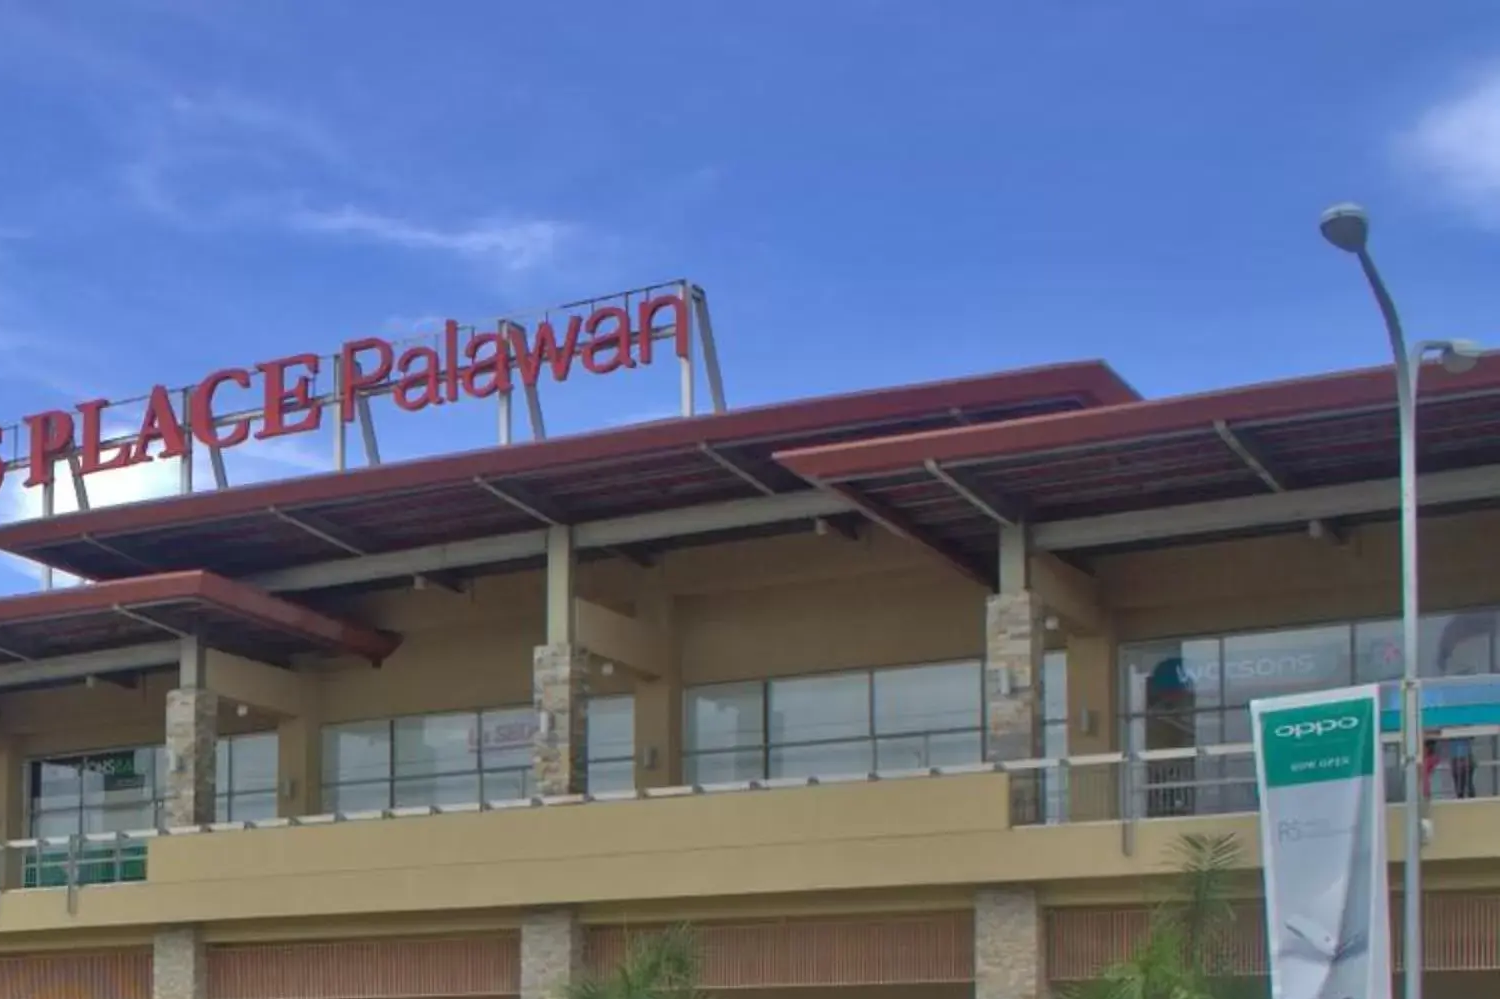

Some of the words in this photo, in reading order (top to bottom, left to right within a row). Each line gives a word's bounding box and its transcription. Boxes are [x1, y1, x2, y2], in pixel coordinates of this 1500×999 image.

[22, 352, 323, 488] PLACE
[341, 293, 688, 422] Palawan
[1274, 715, 1360, 740] oppo
